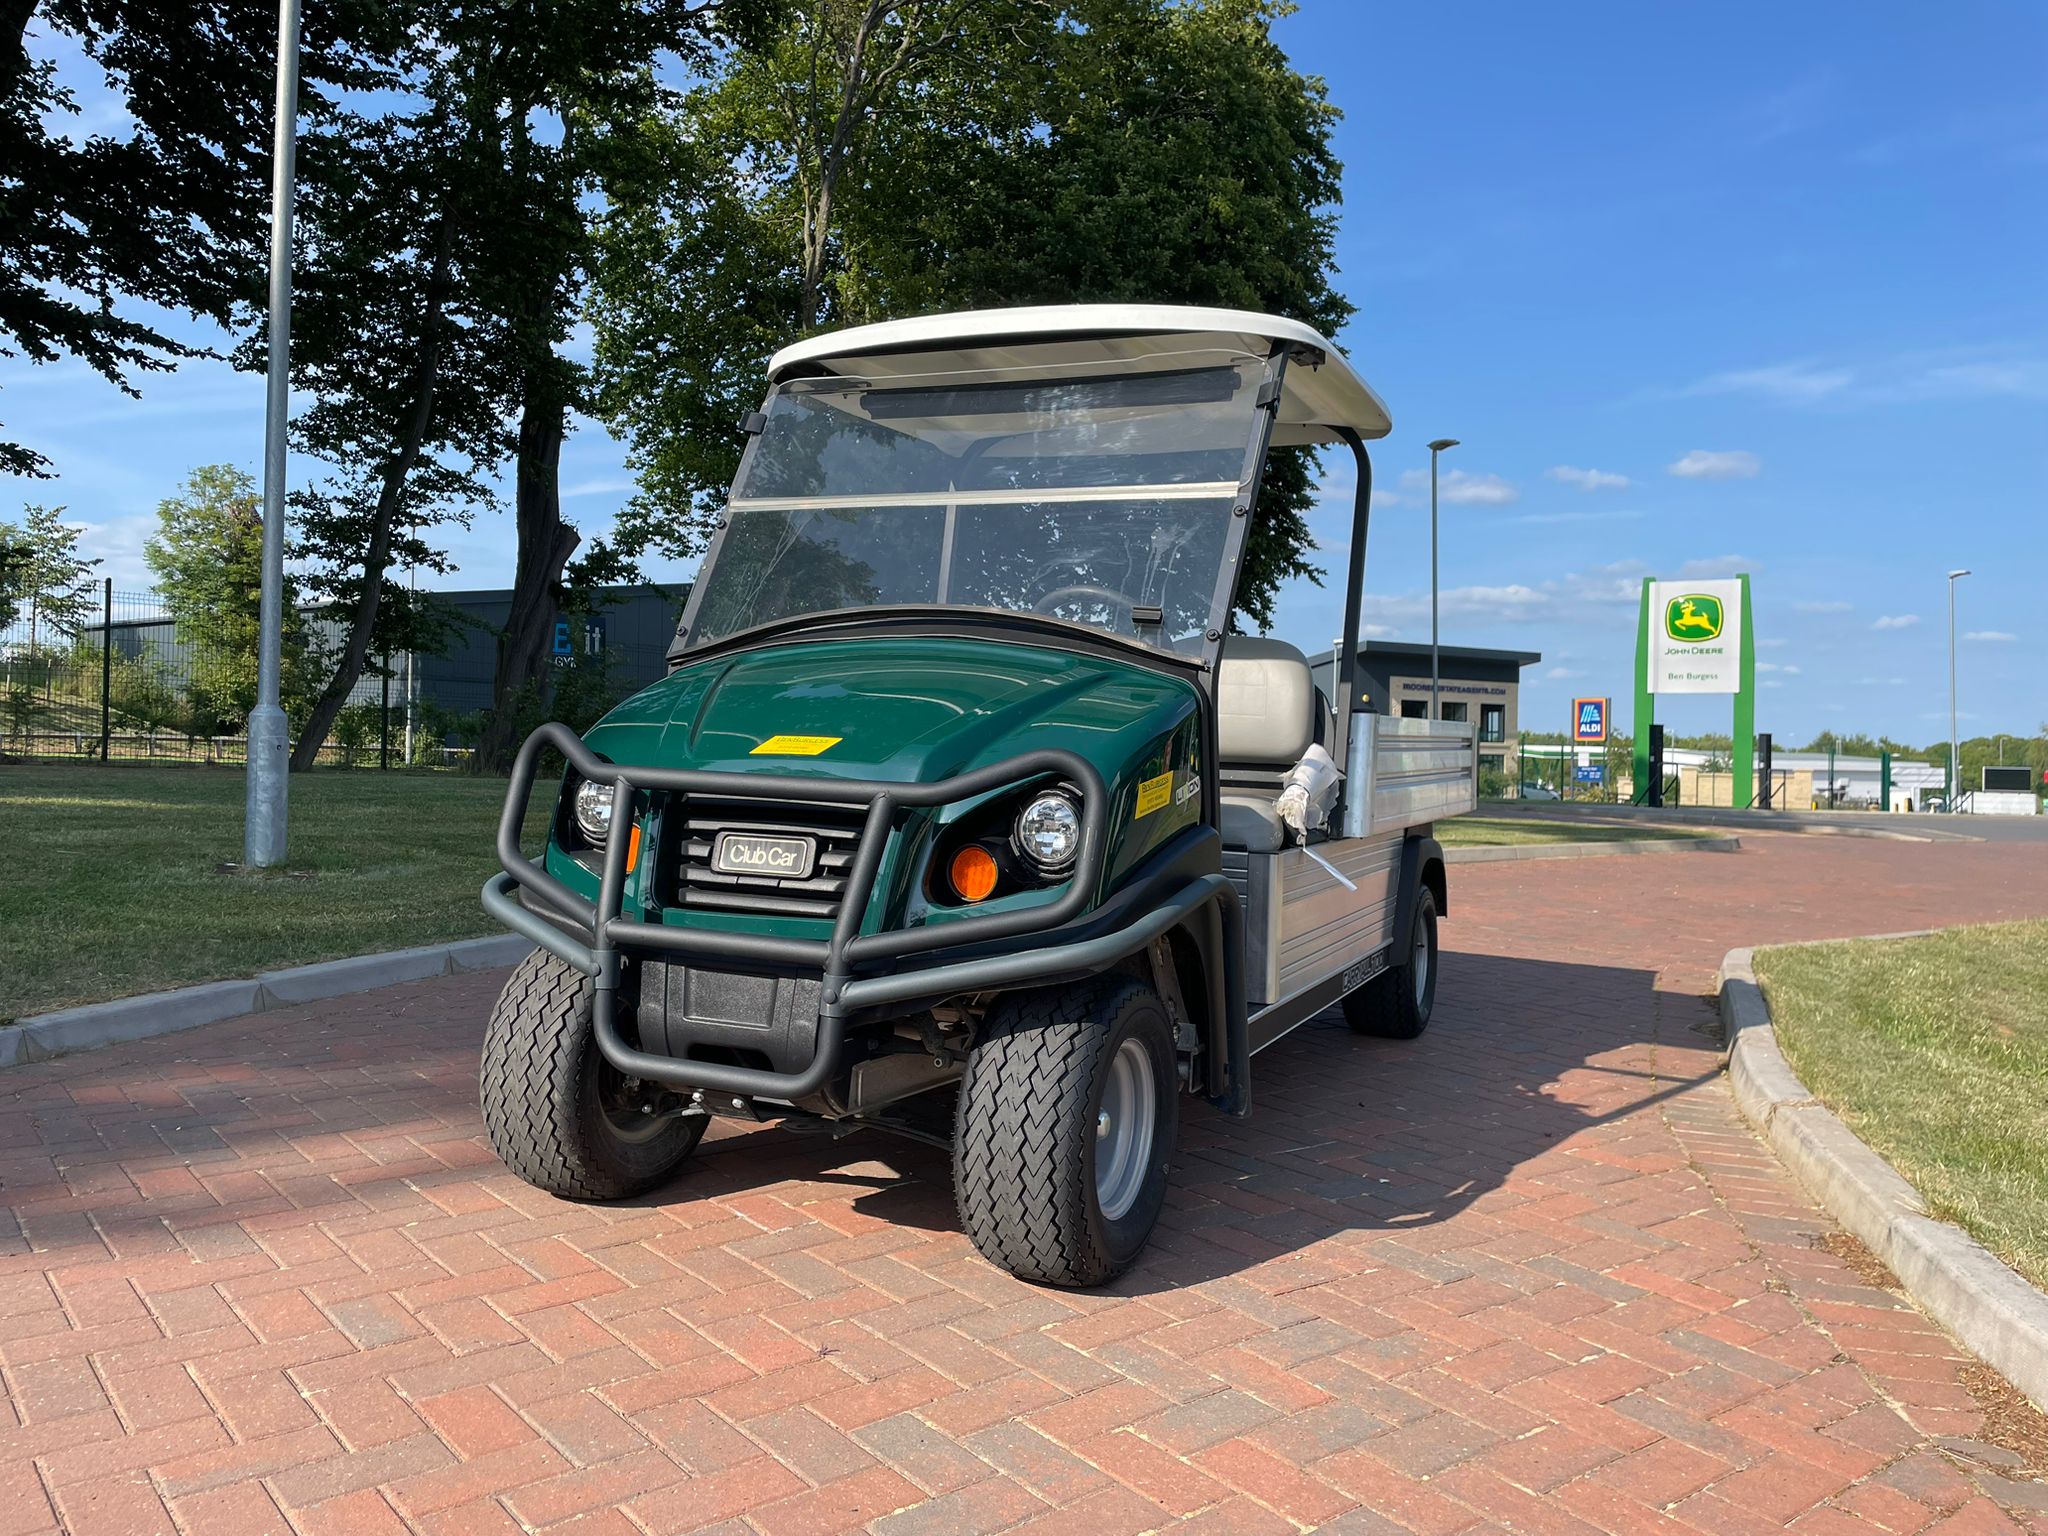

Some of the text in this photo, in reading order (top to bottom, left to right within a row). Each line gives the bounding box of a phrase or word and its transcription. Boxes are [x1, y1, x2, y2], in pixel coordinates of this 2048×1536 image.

[1664, 646, 1723, 655] JOHN DEERE
[1668, 672, 1719, 681] Ben Burgess
[1579, 723, 1601, 732] ALDI
[730, 844, 798, 867] Club Car
